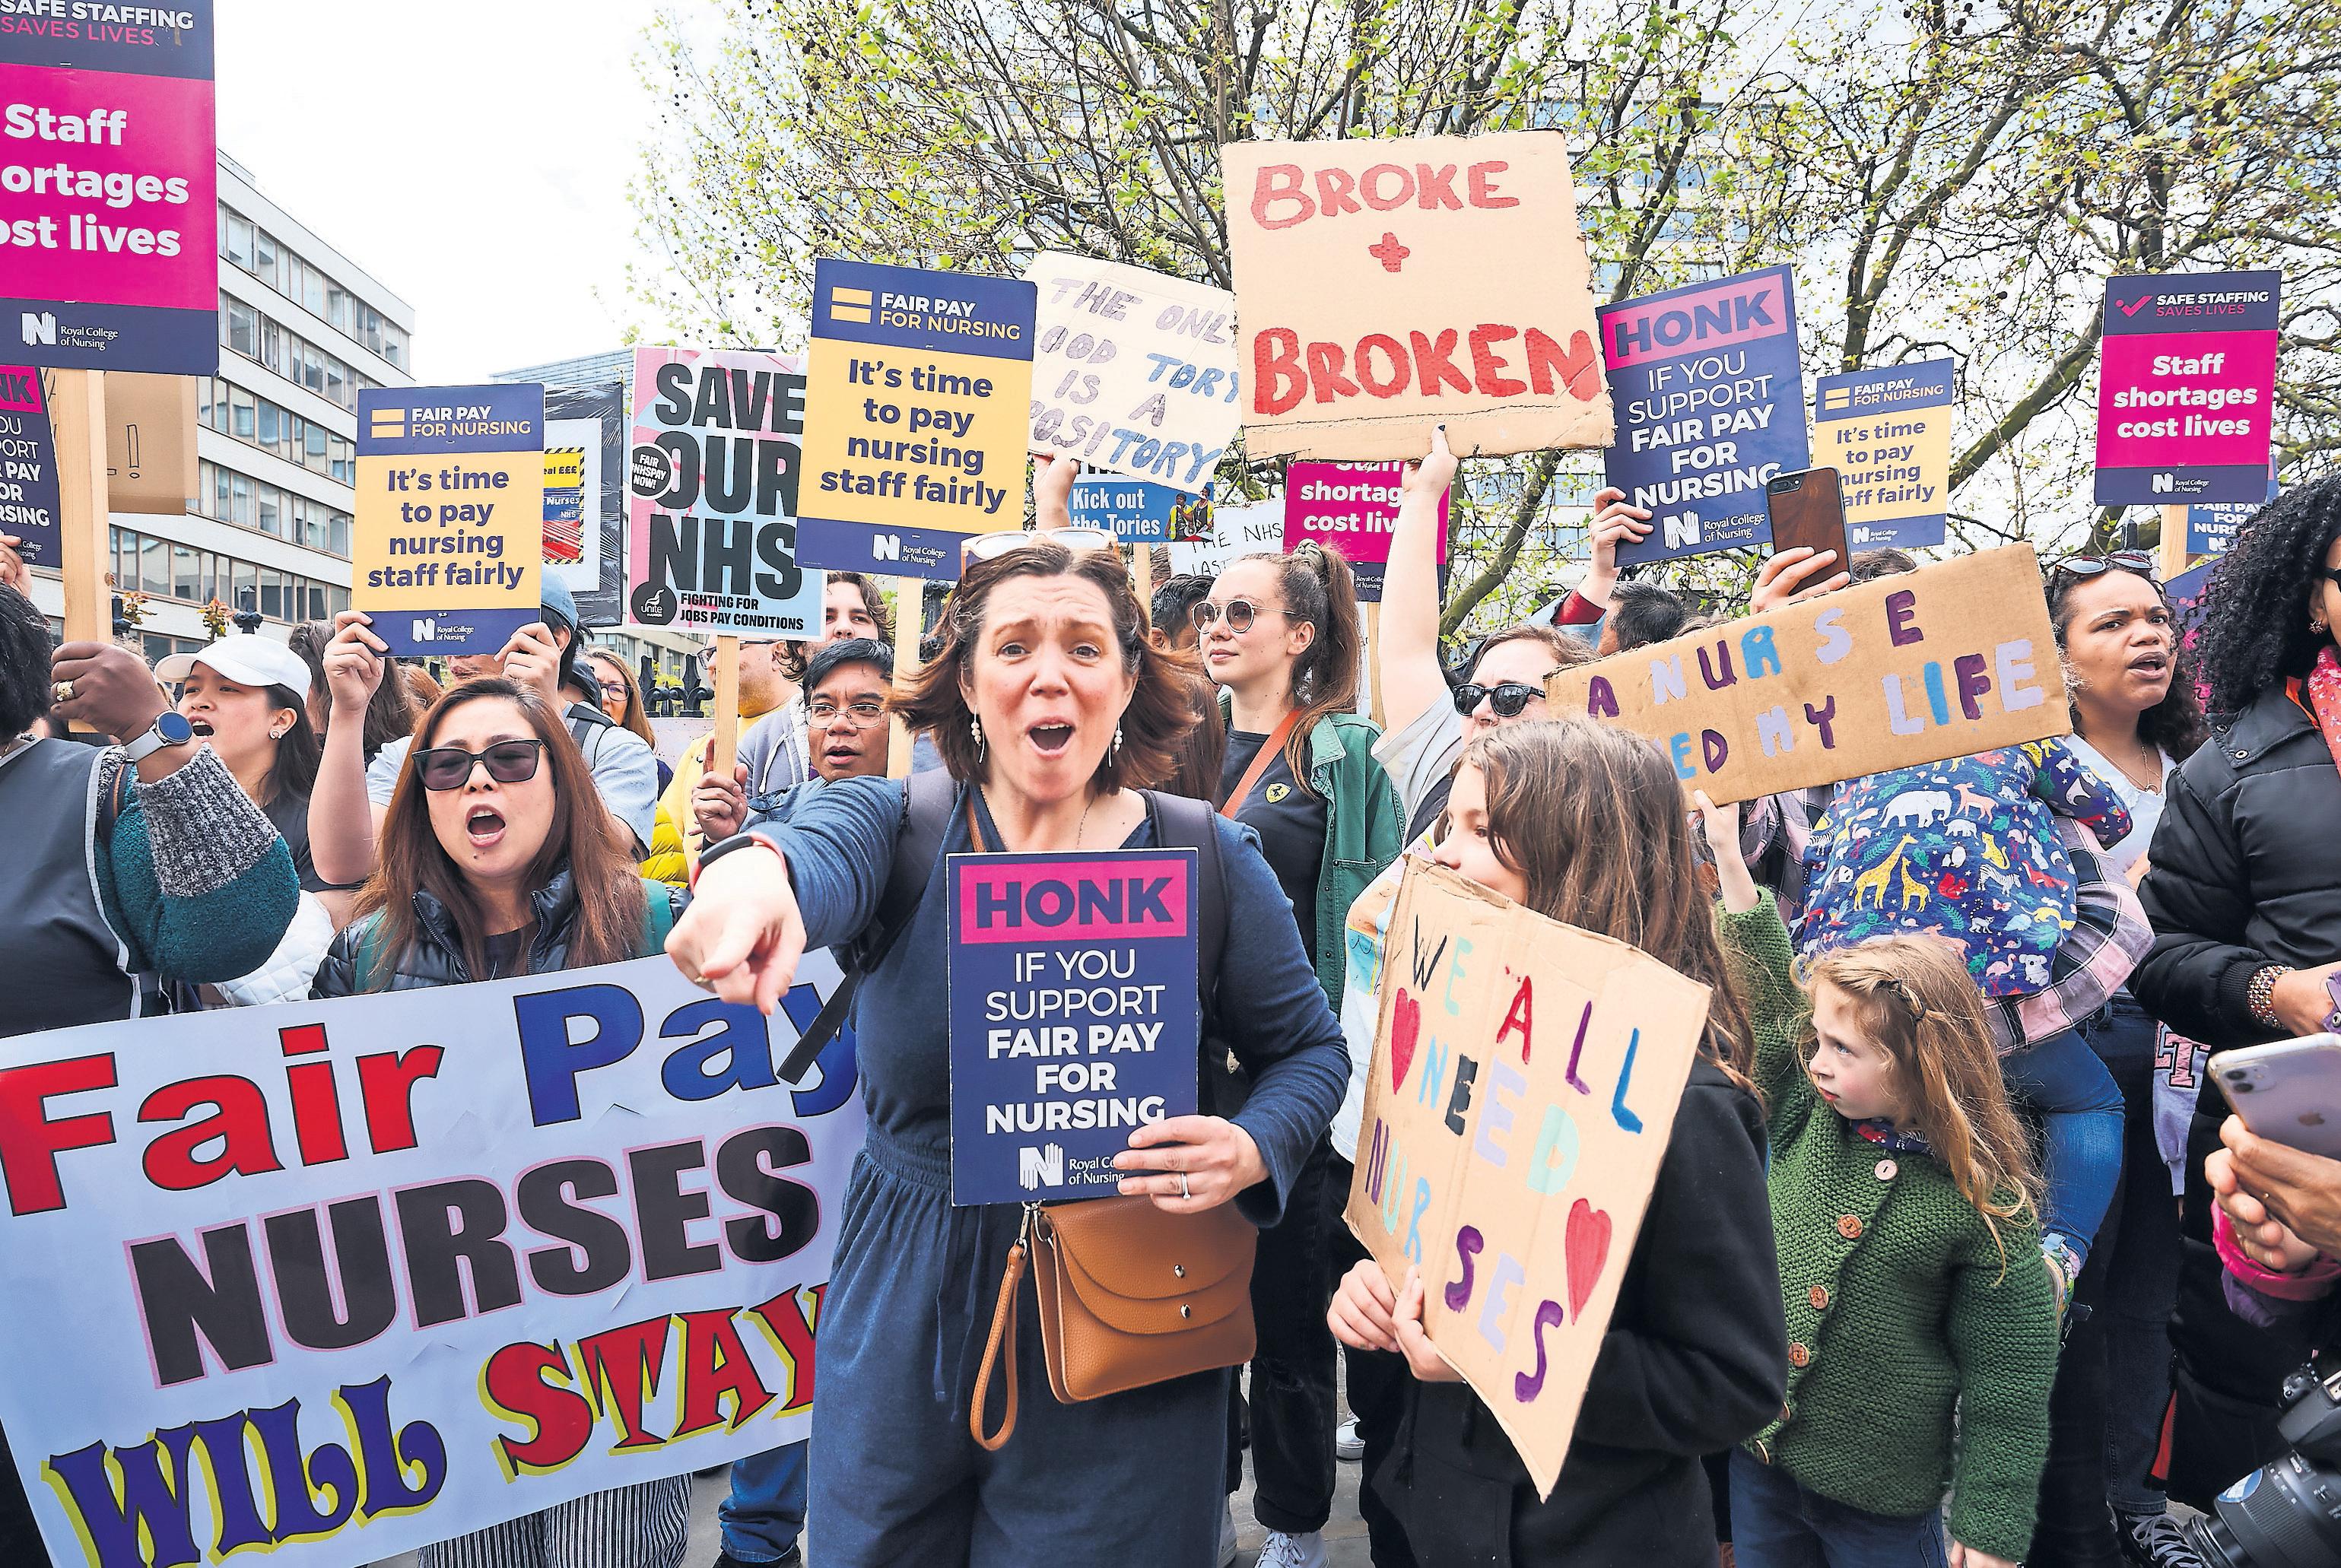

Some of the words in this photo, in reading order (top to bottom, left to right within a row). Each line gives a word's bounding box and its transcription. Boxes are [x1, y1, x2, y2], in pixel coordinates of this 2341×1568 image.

[0, 0, 66, 17] SAFE
[71, 2, 193, 29] STAFFING
[2, 16, 79, 39] SAVES
[88, 24, 154, 46] LIVES
[5, 103, 127, 145] Staff
[2, 163, 189, 208] ortages
[1251, 160, 1520, 230] BROKE
[70, 213, 181, 256] lives
[880, 292, 930, 314] FAIR
[933, 299, 976, 317] PAY
[2156, 294, 2195, 306] SAFE
[2198, 290, 2270, 304] STAFFING
[2156, 304, 2202, 316] SAVES
[2206, 304, 2245, 315] LIVES
[880, 310, 921, 329] FOR
[928, 316, 1021, 341] NURSING
[1050, 278, 1143, 322] THE
[1155, 305, 1237, 348] ONL
[1615, 290, 1776, 357] HONK
[61, 326, 84, 338] Royal
[86, 328, 118, 341] College
[61, 338, 71, 346] of
[72, 338, 106, 351] Nursing
[1037, 324, 1117, 363] OOD
[1146, 352, 1239, 403] TORY
[1253, 324, 1602, 416] BROKEN
[1649, 366, 1672, 392] IF
[1679, 351, 1745, 383] YOU
[2152, 353, 2225, 376] Staff
[849, 358, 902, 389] It's
[910, 364, 994, 398] time
[1854, 382, 1885, 395] FAIR
[1887, 377, 1914, 391] PAY
[656, 363, 807, 435] SAVE
[1054, 370, 1101, 405] IS
[1128, 393, 1166, 427] A
[1628, 375, 1773, 424] SUPPORT
[1854, 393, 1880, 406] FOR
[1883, 384, 1943, 402] NURSING
[2114, 386, 2257, 410] shortages
[411, 408, 453, 421] FAIR
[456, 406, 491, 421] PAY
[864, 398, 901, 424] to
[910, 407, 975, 438] pay
[2117, 418, 2179, 438] cost
[2184, 414, 2250, 436] lives
[411, 424, 446, 437] FOR
[452, 421, 531, 436] NURSING
[1631, 418, 1704, 452] FAIR
[1711, 404, 1775, 437] PAY
[1837, 427, 1868, 444] It's
[1874, 421, 1926, 440] time
[639, 453, 659, 468] FAIR
[848, 436, 984, 476] nursing
[1671, 442, 1738, 474] FOR
[1846, 450, 1868, 464] to
[1874, 444, 1914, 465] pay
[5, 461, 41, 481] PAY
[388, 468, 432, 491] It's
[440, 465, 510, 490] time
[558, 465, 577, 475] £££
[634, 475, 656, 489] NOW!
[654, 430, 802, 517] OUR
[1841, 465, 1920, 485] nursing
[820, 469, 907, 498] staff
[913, 475, 1007, 514] fairly
[1072, 487, 1110, 510] Kick
[1116, 489, 1145, 509] out
[1634, 462, 1782, 509] NURSING
[1877, 484, 1935, 503] fairly
[546, 497, 580, 506] Nurses
[561, 510, 577, 519] NHS
[402, 503, 431, 522] to
[440, 503, 494, 528] pay
[1072, 514, 1101, 529] the
[1107, 514, 1161, 535] Tories
[1304, 513, 1360, 532] cost
[1704, 519, 1729, 532] Royal
[1730, 512, 1765, 527] College
[2214, 513, 2247, 524] FOR
[389, 530, 503, 557] nursing
[1244, 523, 1283, 542] NHS
[1704, 531, 1716, 542] of
[1717, 526, 1752, 540] Nursing
[23, 541, 42, 551] College
[649, 514, 802, 600] NHS
[903, 544, 920, 557] Royal
[922, 546, 947, 560] College
[901, 553, 910, 563] of
[910, 554, 936, 567] Nursing
[368, 563, 438, 587] staff
[445, 562, 525, 590] fairly
[641, 605, 663, 614] unite
[681, 593, 735, 608] FIGHTING
[736, 598, 759, 610] FOR
[437, 626, 453, 635] Royal
[453, 626, 474, 636] College
[680, 610, 708, 623] JOBS
[710, 612, 731, 624] PAY
[733, 614, 804, 630] CONDITIONS
[437, 633, 443, 641] of
[443, 633, 466, 643] Nursing
[1588, 675, 1619, 718] A
[1650, 590, 1923, 706] NURSE
[1669, 729, 1728, 779] ED
[1756, 695, 1836, 759] MY
[1881, 639, 2044, 736] LIFE
[976, 877, 1175, 928] HONK
[1015, 951, 1046, 982] IF
[1055, 948, 1136, 981] YOU
[985, 985, 1166, 1020] SUPPORT
[1413, 914, 1473, 1017] WE
[1496, 974, 1643, 1134] ALL
[988, 1026, 1079, 1059] FAIR
[1088, 1022, 1165, 1055] PAY
[1036, 1062, 1117, 1094] FOR
[0, 1023, 443, 1216] Fair
[513, 984, 859, 1127] Pay
[986, 1096, 1166, 1135] NURSING
[1418, 1036, 1580, 1194] NEED
[1069, 1157, 1100, 1173] Royal
[1069, 1172, 1082, 1184] of
[1083, 1172, 1125, 1185] Nursing
[124, 1122, 821, 1389] NURSES
[1365, 1117, 1563, 1402] NURSES
[43, 1374, 447, 1568] WILL
[480, 1283, 825, 1483] STAY
